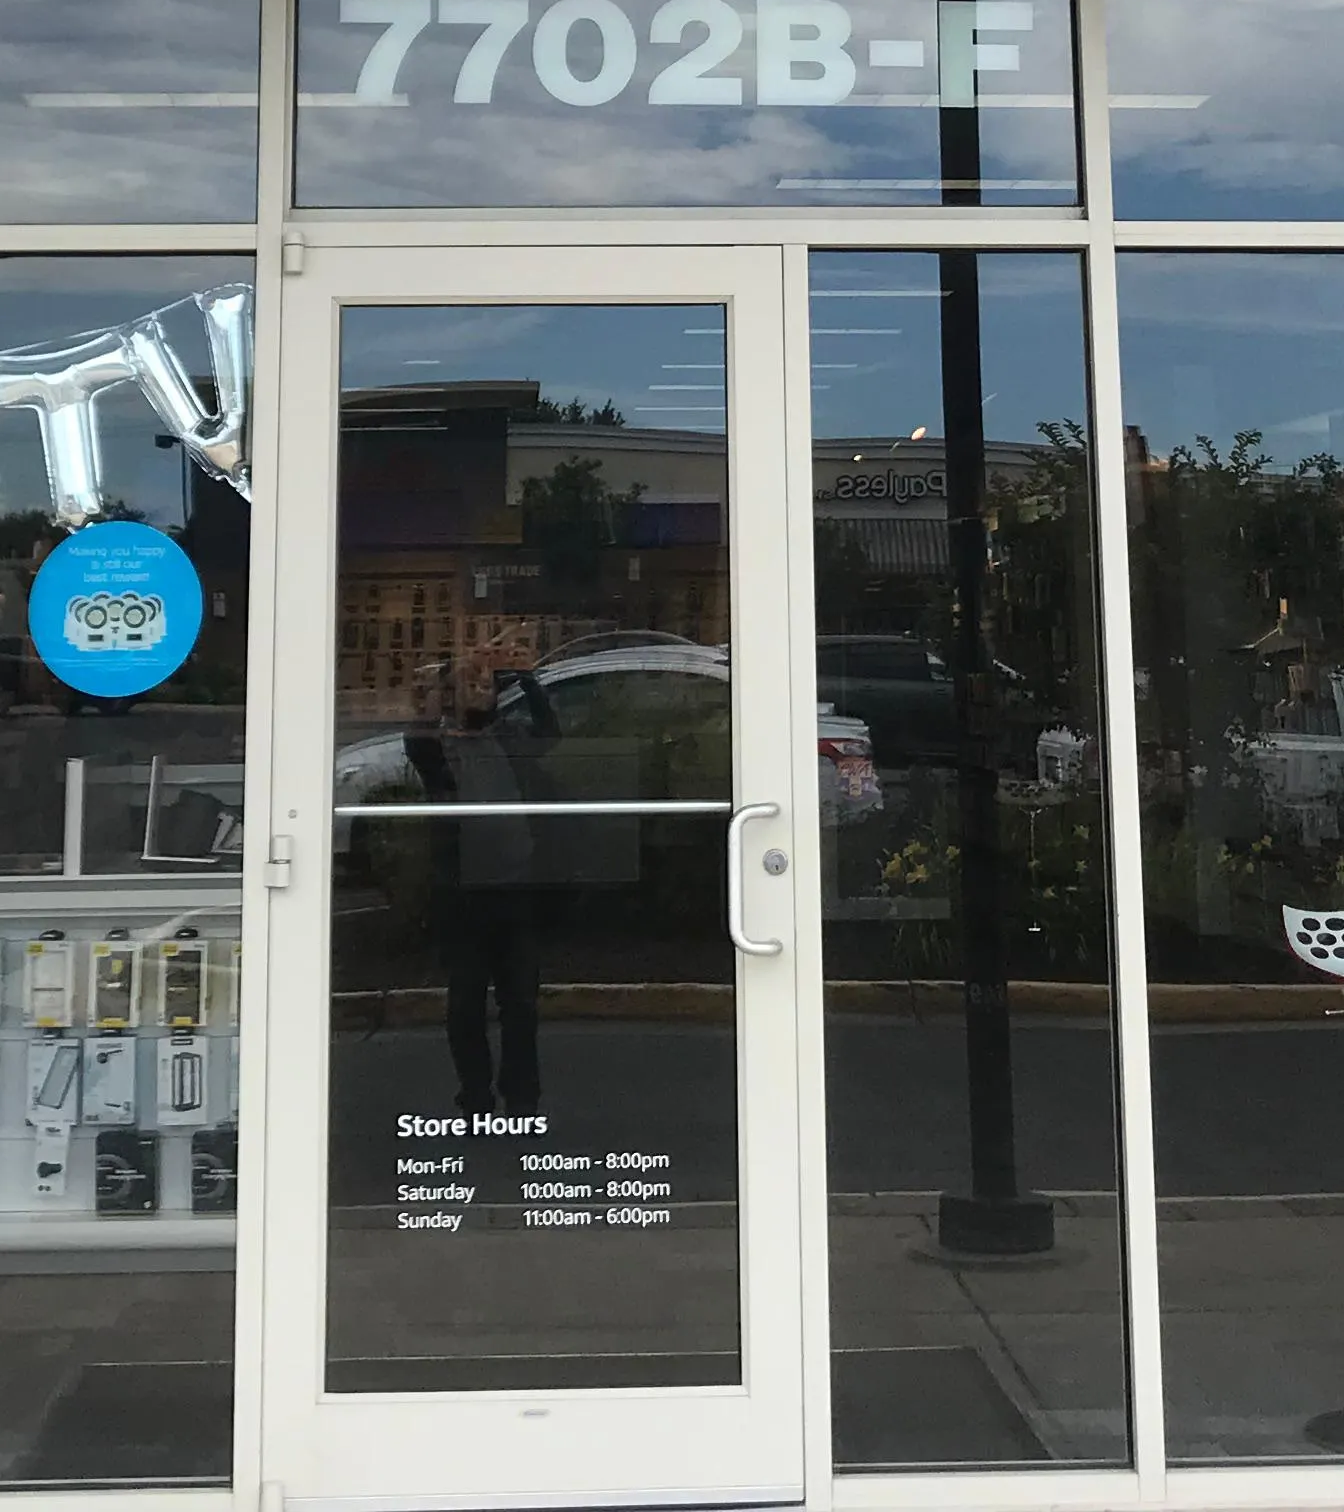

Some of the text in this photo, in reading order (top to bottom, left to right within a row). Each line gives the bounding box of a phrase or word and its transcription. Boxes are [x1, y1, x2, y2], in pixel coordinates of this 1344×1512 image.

[397, 1112, 548, 1137] Store Hours
[397, 1156, 464, 1174] Mon-Fri
[520, 1154, 591, 1171] 10:00am
[605, 1152, 670, 1172] 8:00pm
[397, 1183, 475, 1203] Saturday
[520, 1181, 592, 1199] 10:00am
[606, 1180, 671, 1200] 8:00pm
[397, 1211, 463, 1232] Sunday
[522, 1209, 592, 1227] 11:00am
[606, 1207, 670, 1227] 6:00pm
